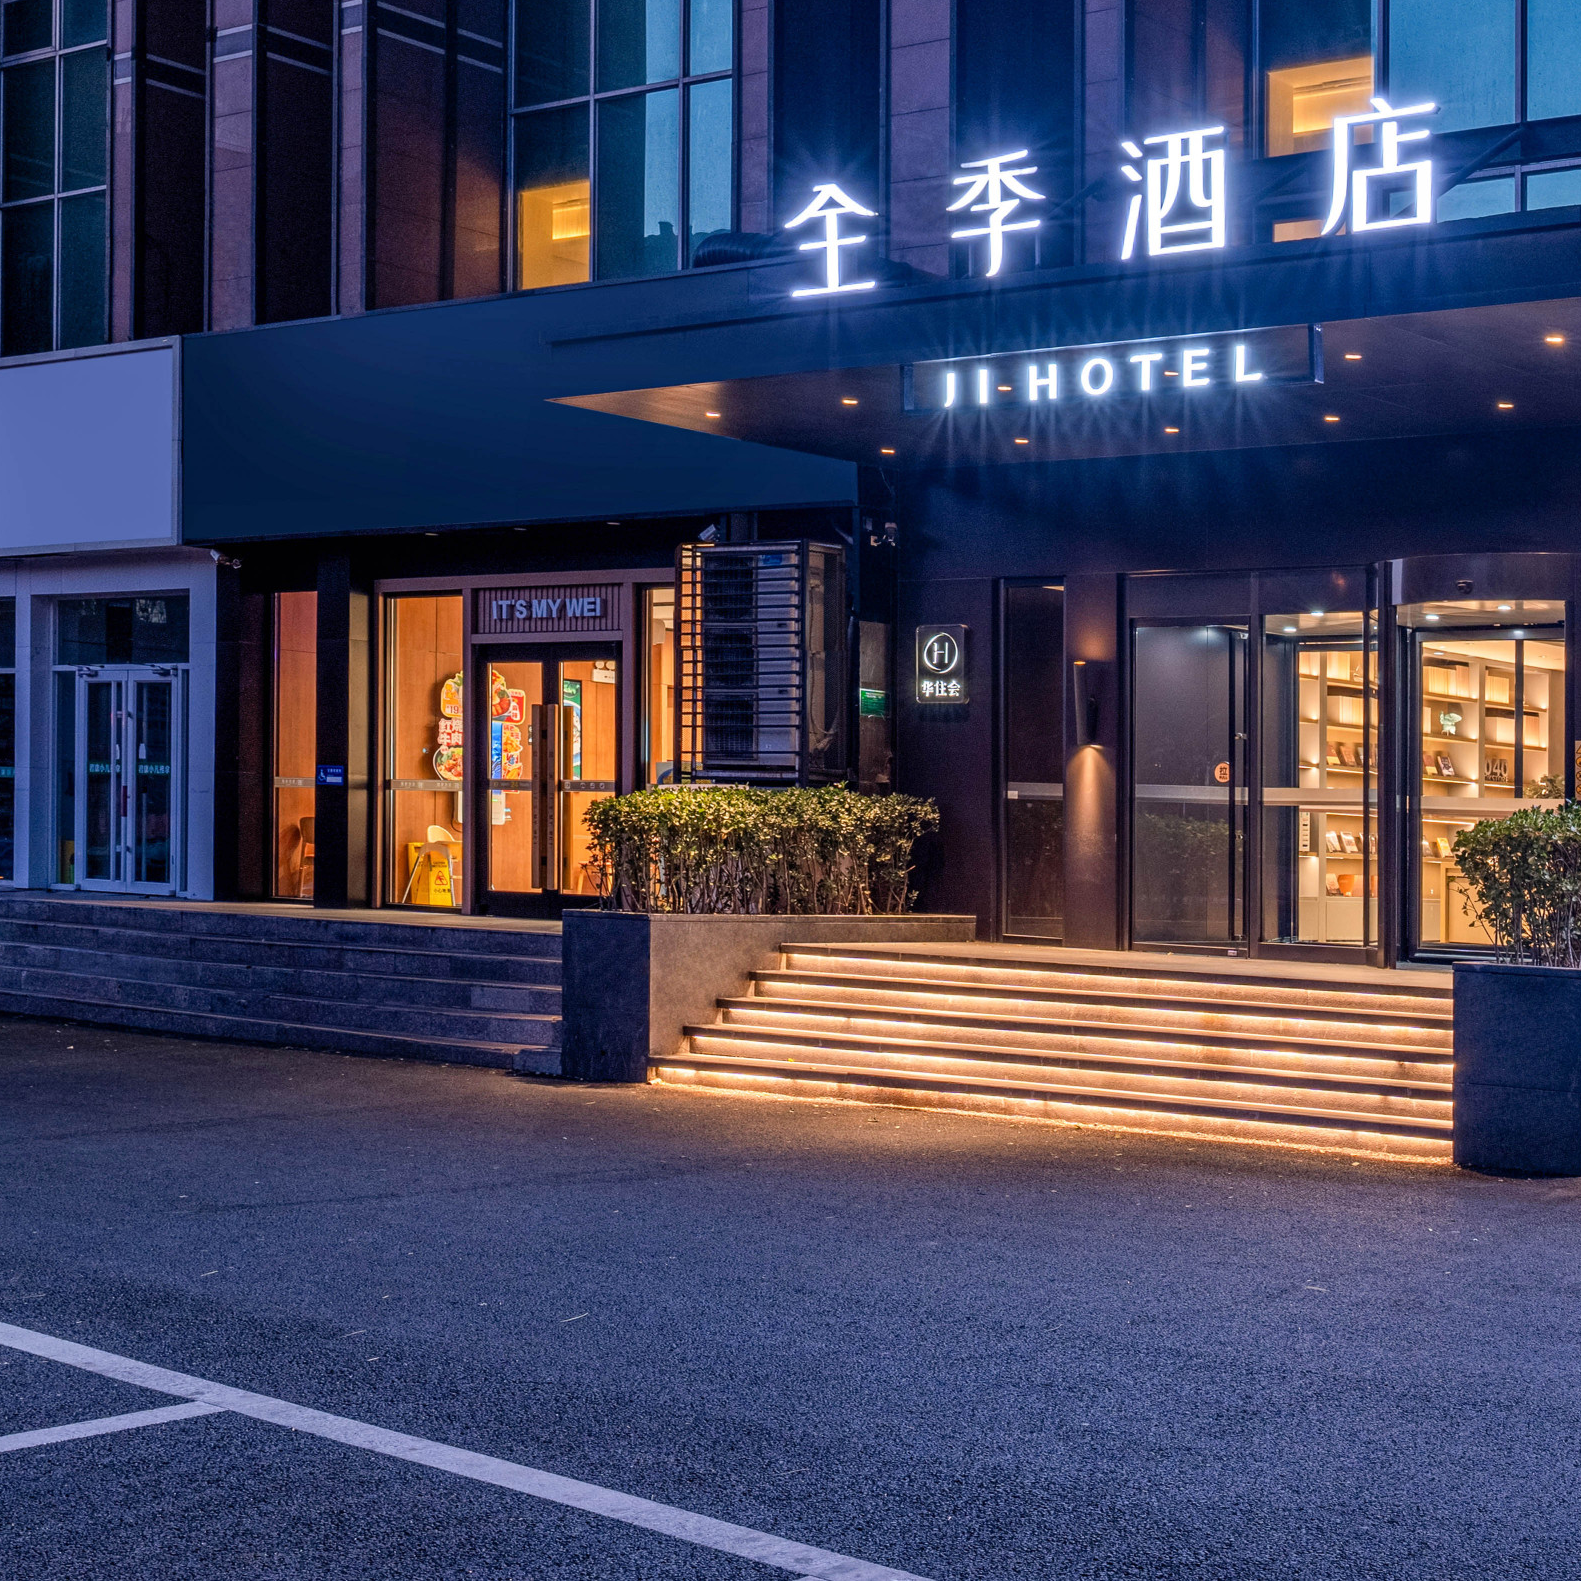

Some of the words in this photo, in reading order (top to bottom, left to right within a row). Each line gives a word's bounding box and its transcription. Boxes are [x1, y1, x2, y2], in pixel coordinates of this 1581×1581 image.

[784, 98, 1437, 298] 全季酒店
[944, 369, 989, 408] JI
[1028, 345, 1263, 402] HOTEL
[492, 599, 527, 619] IT'S
[532, 599, 561, 618] MY
[565, 597, 601, 617] WEI
[921, 680, 961, 697] 华住会
[1219, 766, 1227, 775] 拉
